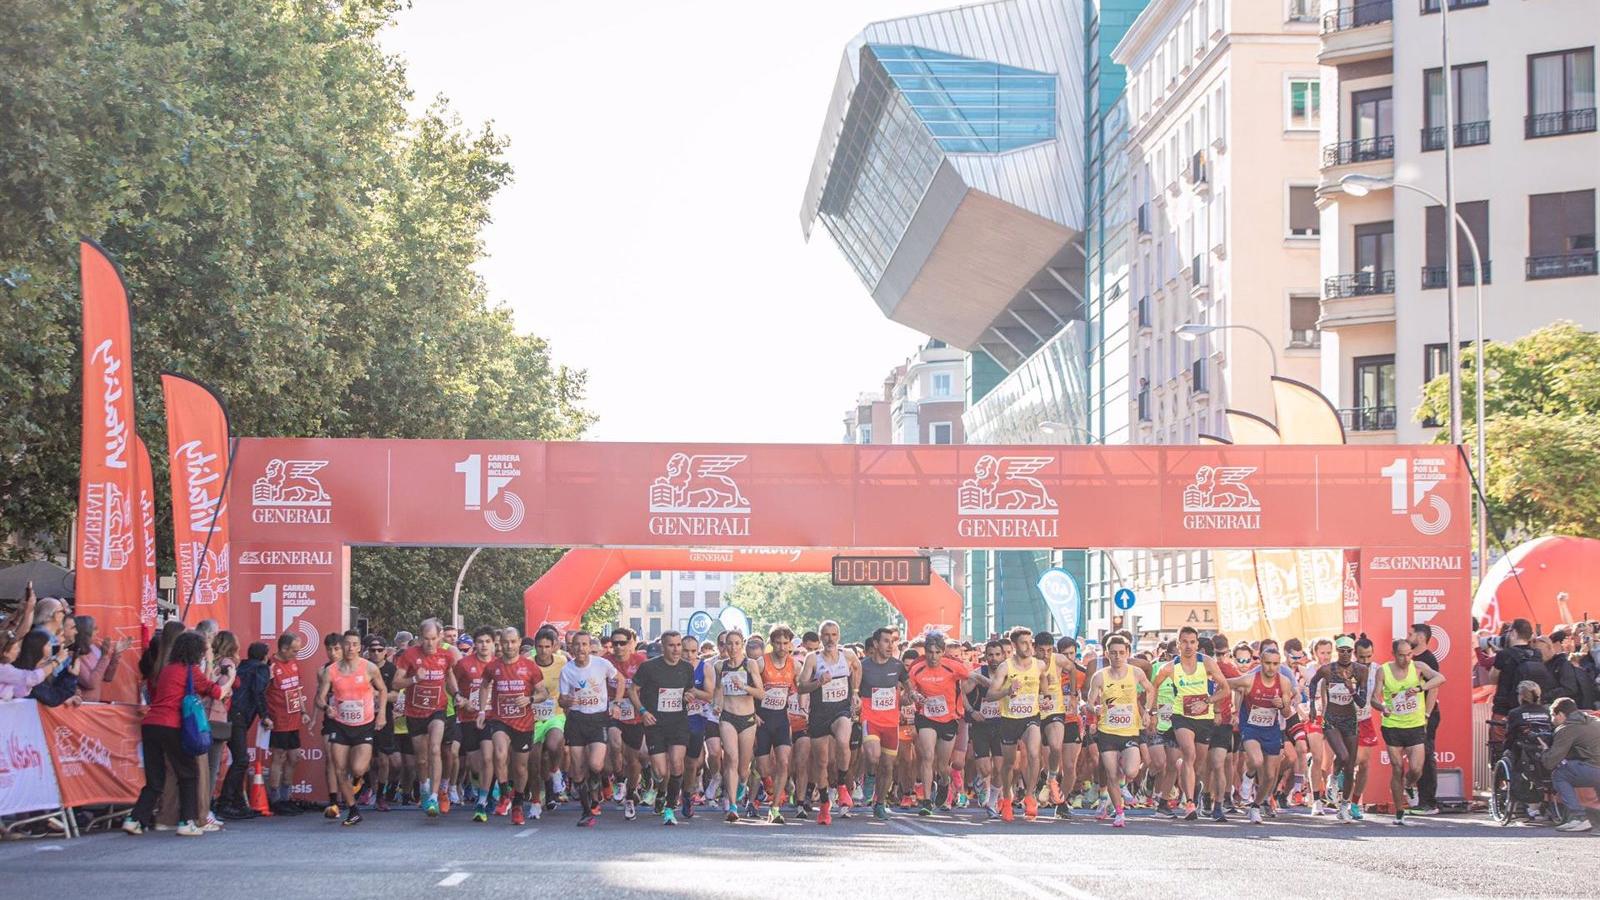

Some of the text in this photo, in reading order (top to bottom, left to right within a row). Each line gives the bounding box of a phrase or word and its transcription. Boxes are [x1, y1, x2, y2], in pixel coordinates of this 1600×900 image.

[252, 508, 332, 524] GENERALI
[649, 516, 751, 536] GENERALI
[1183, 514, 1261, 530] GENERALI
[958, 518, 1059, 538] GENERALI
[260, 551, 333, 565] GENERALI
[689, 553, 734, 562] GENERALI
[1391, 556, 1463, 570] GENERALI
[282, 584, 315, 592] CARRERA
[825, 689, 847, 698] 1150
[423, 697, 430, 705] 2
[662, 700, 681, 708] 1152
[764, 697, 785, 706] 2850
[875, 699, 894, 707] 1452
[503, 706, 521, 714] 154
[1010, 705, 1033, 714] 6030
[1395, 701, 1417, 712] 2185
[1108, 715, 1131, 724] 2900
[1251, 715, 1273, 724] 6372
[264, 748, 323, 760] MRID
